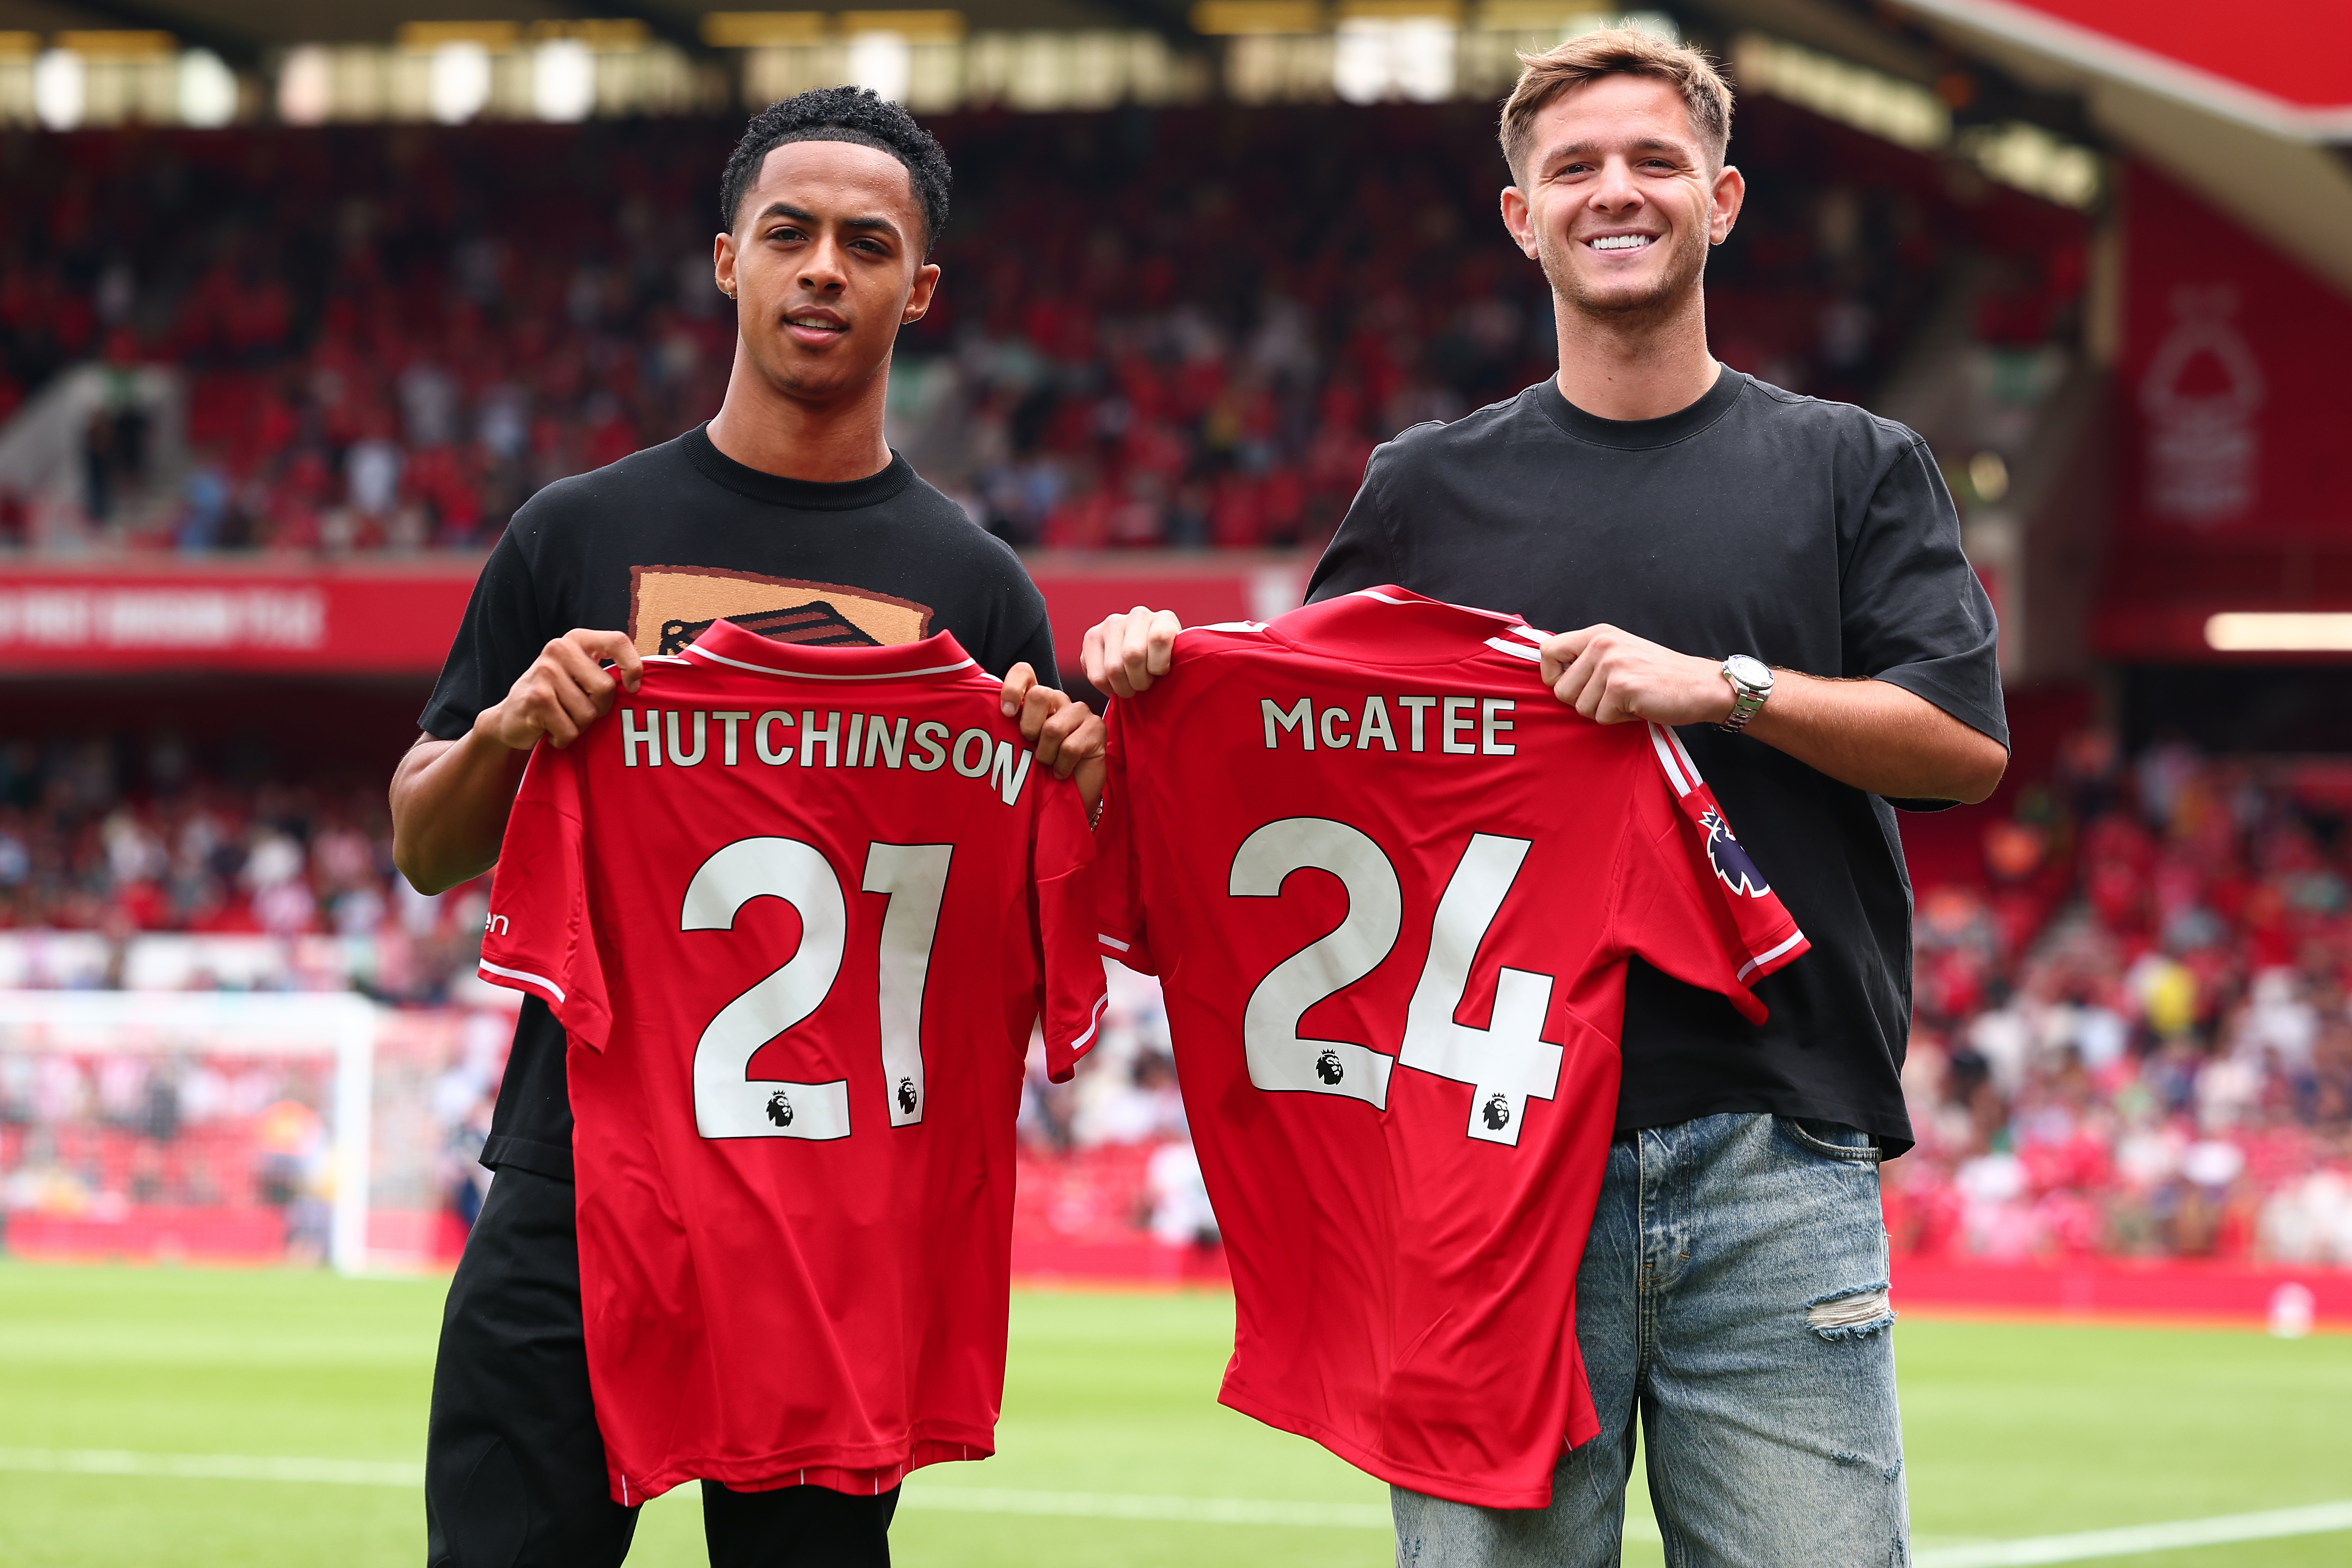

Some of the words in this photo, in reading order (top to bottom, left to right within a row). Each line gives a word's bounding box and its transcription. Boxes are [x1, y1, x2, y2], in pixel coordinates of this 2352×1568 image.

[620, 708, 1033, 807] HUTCHINSON
[1260, 695, 1517, 756] McATEE
[681, 836, 954, 1141] 21
[1228, 816, 1565, 1147] 24
